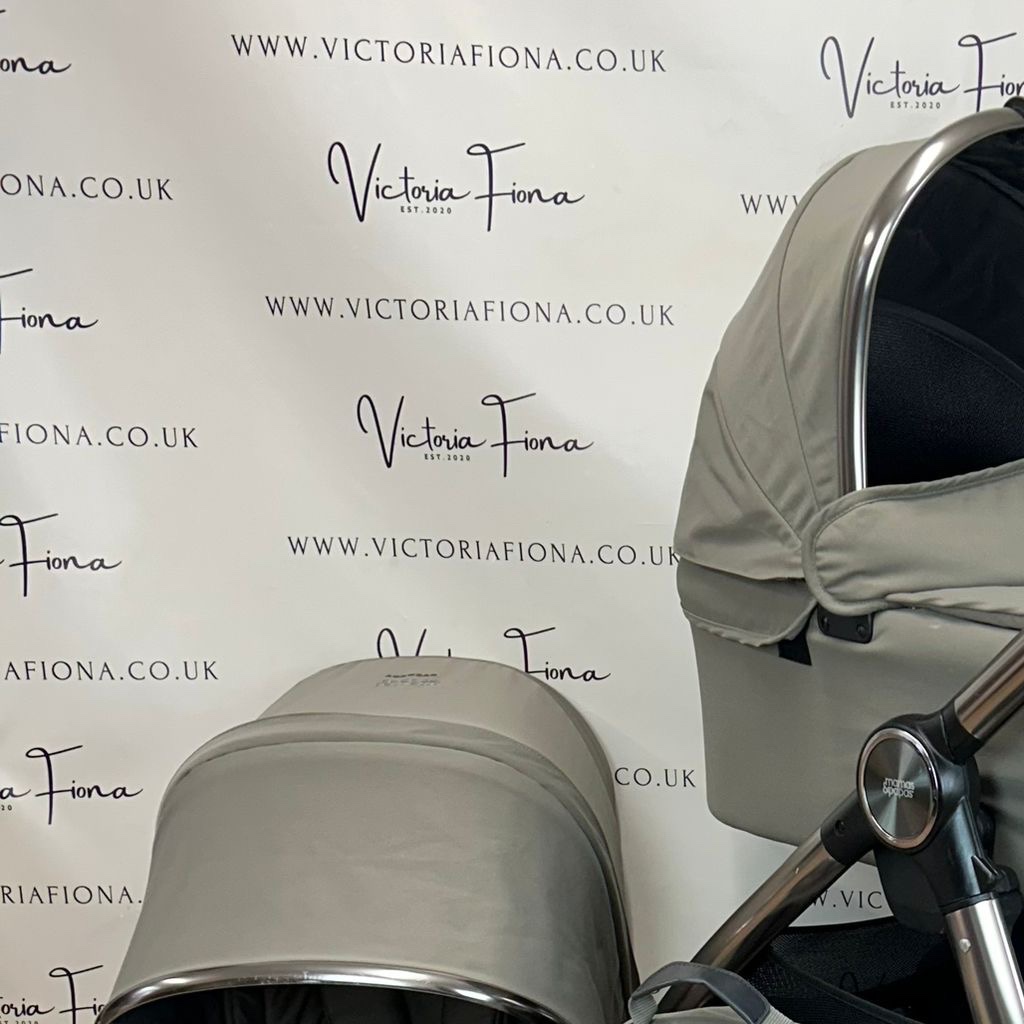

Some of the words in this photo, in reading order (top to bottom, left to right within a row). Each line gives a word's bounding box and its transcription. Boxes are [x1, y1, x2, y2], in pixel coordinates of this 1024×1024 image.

[231, 34, 667, 73] WWW.VICTORIAFIONA.CO.UK
[820, 36, 960, 118] Victoria
[890, 101, 941, 109] EST.2020
[328, 141, 471, 222] Victoria
[467, 142, 585, 232] Fiona
[401, 206, 452, 214] EST.2020
[265, 296, 674, 326] WWW.VICTORIAFIONA.CO.UK
[357, 394, 487, 468] Victoria
[481, 392, 594, 477] Fiona
[0, 513, 122, 596] Fiona
[26, 745, 143, 825] Fiona
